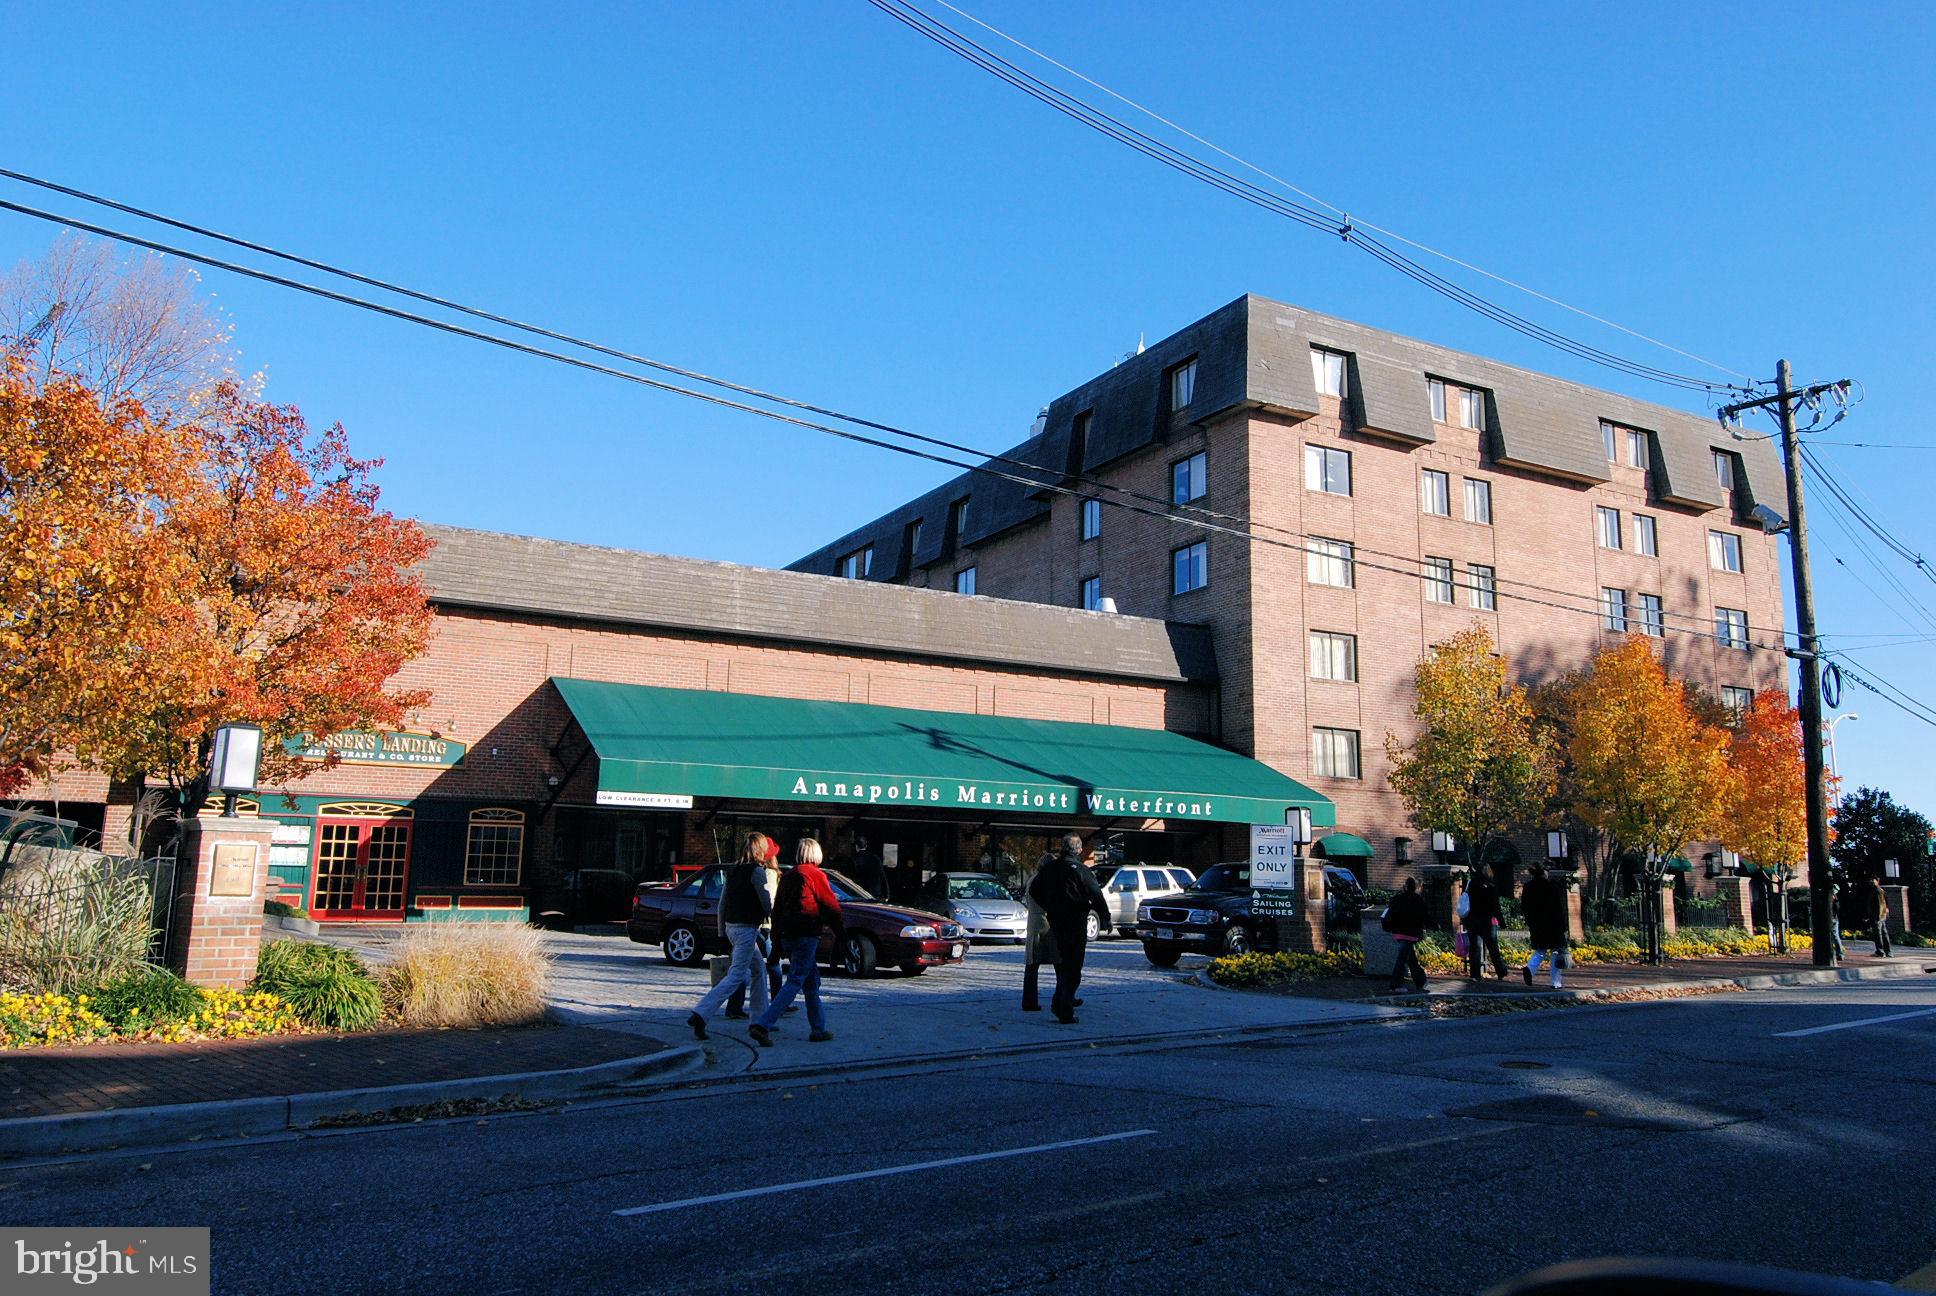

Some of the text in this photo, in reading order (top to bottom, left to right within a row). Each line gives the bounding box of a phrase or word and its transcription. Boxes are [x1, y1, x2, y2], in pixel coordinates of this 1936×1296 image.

[382, 736, 447, 754] LANDING
[306, 749, 375, 759] RESURANT
[378, 752, 386, 760] &
[409, 754, 442, 763] STORE
[791, 776, 1212, 816] Annapolis Marriott Waterfront
[1258, 845, 1286, 855] EXIT
[1256, 862, 1287, 872] ONLY
[1253, 900, 1292, 908] SAILING
[1251, 907, 1294, 916] CRUISES
